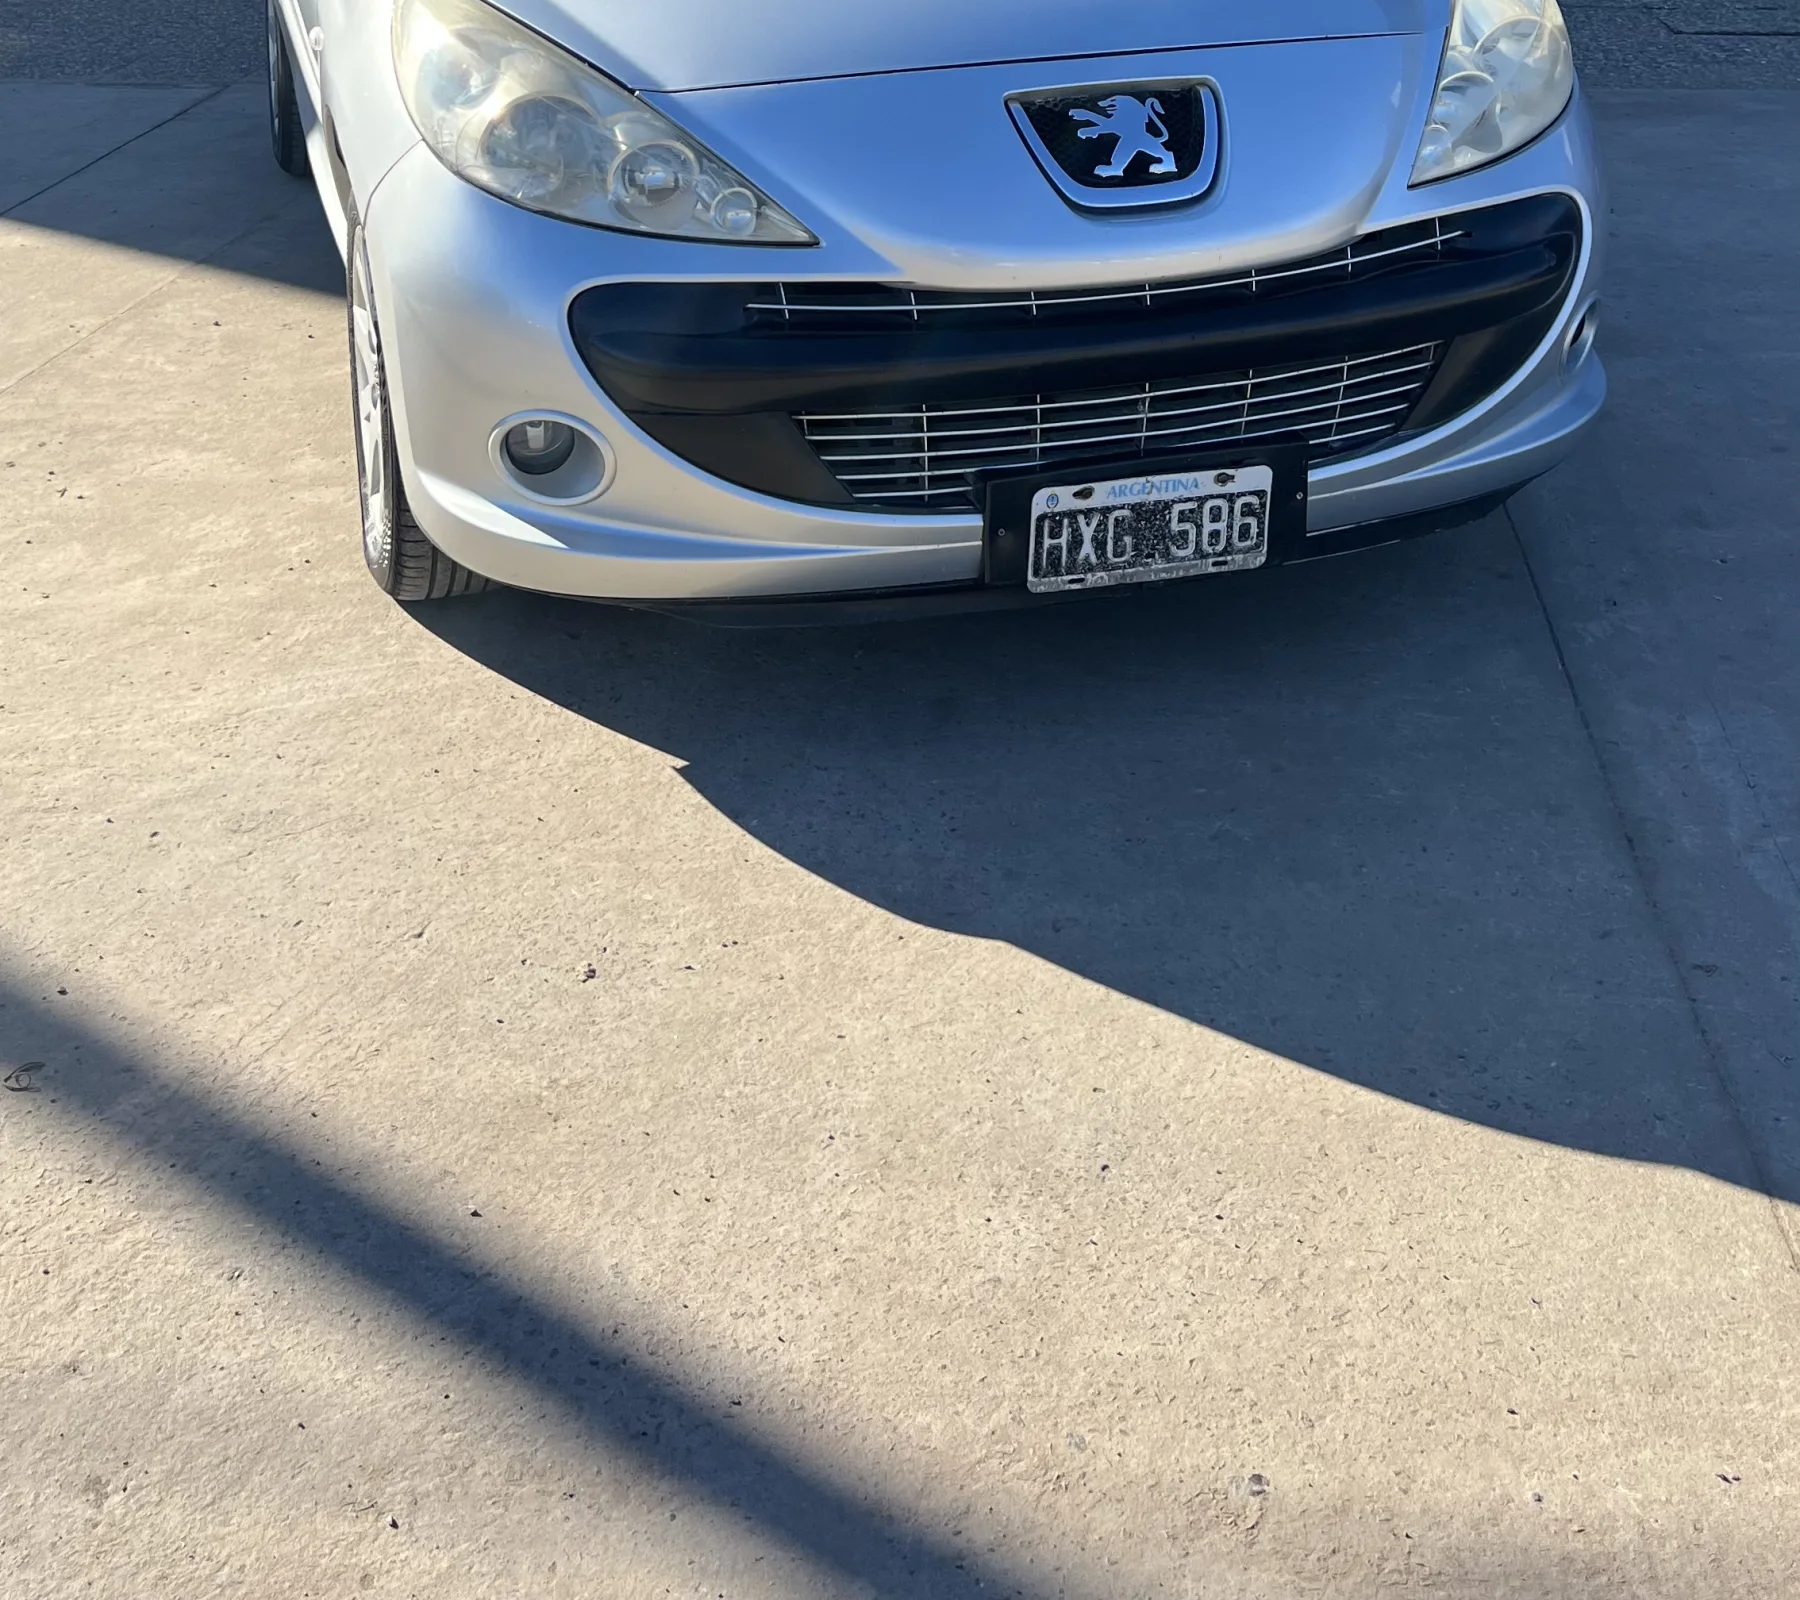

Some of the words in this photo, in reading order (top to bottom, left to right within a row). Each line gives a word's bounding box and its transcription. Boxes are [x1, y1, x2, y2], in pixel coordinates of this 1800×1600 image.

[1107, 477, 1200, 499] ARGENTINA
[1043, 508, 1133, 569] HXG
[1170, 494, 1260, 557] 586
